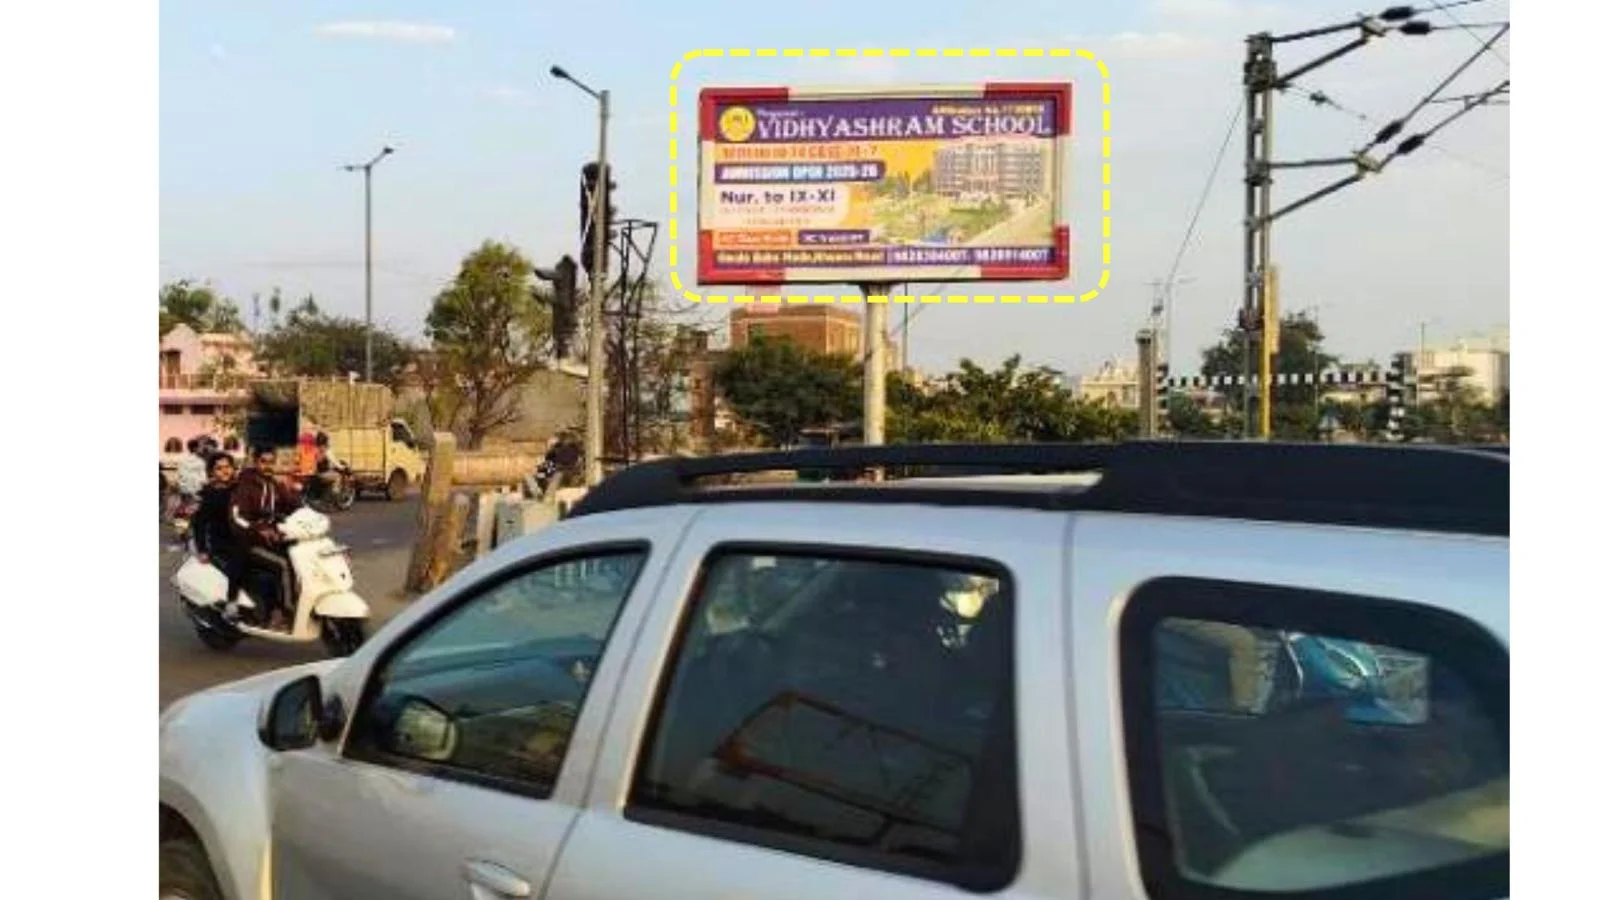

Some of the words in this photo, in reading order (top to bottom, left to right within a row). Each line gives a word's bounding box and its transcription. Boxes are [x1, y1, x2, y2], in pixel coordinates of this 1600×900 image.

[756, 115, 945, 140] VIDHYASHRAM
[951, 114, 1053, 135] SCHOOL
[720, 190, 759, 204] Nur.
[764, 190, 784, 204] to
